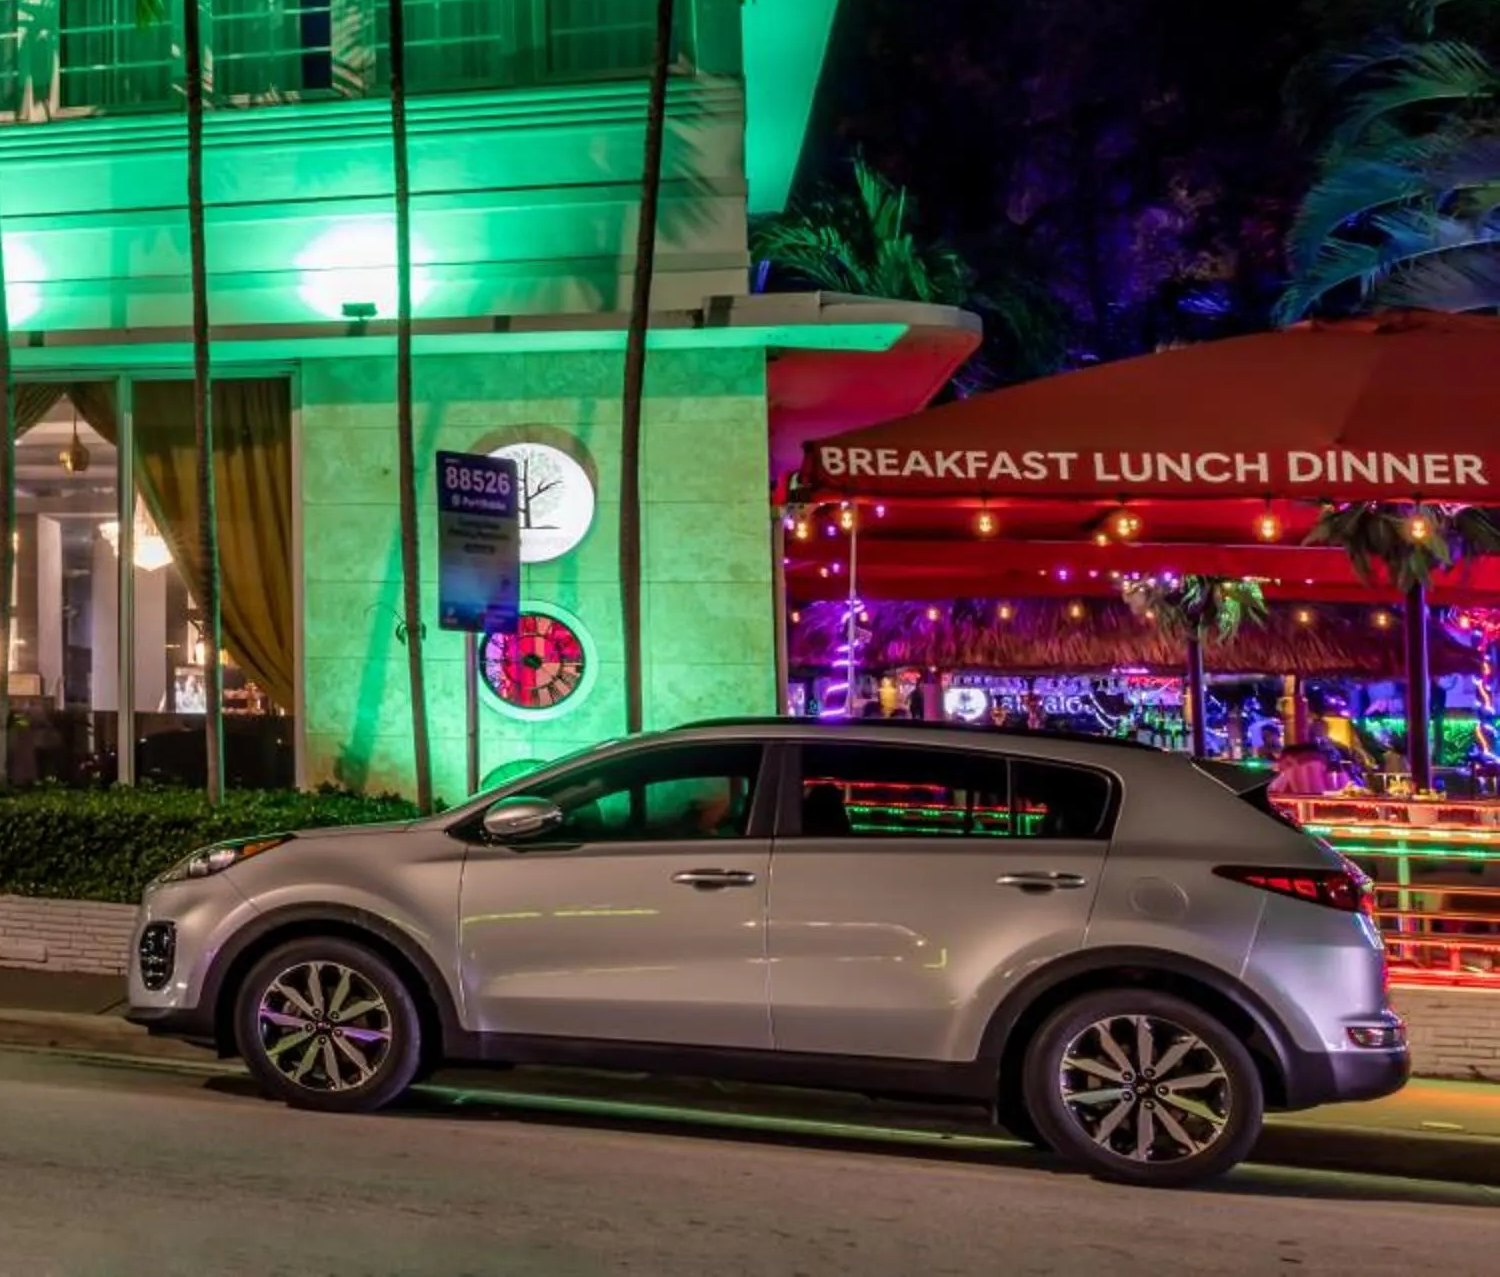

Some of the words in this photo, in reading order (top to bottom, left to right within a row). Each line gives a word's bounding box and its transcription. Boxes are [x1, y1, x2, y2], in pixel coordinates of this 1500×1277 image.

[445, 466, 511, 496] 88526
[820, 446, 1078, 481] BREAKFAST
[1094, 451, 1269, 483] LUNCH
[1287, 450, 1490, 485] DINNER
